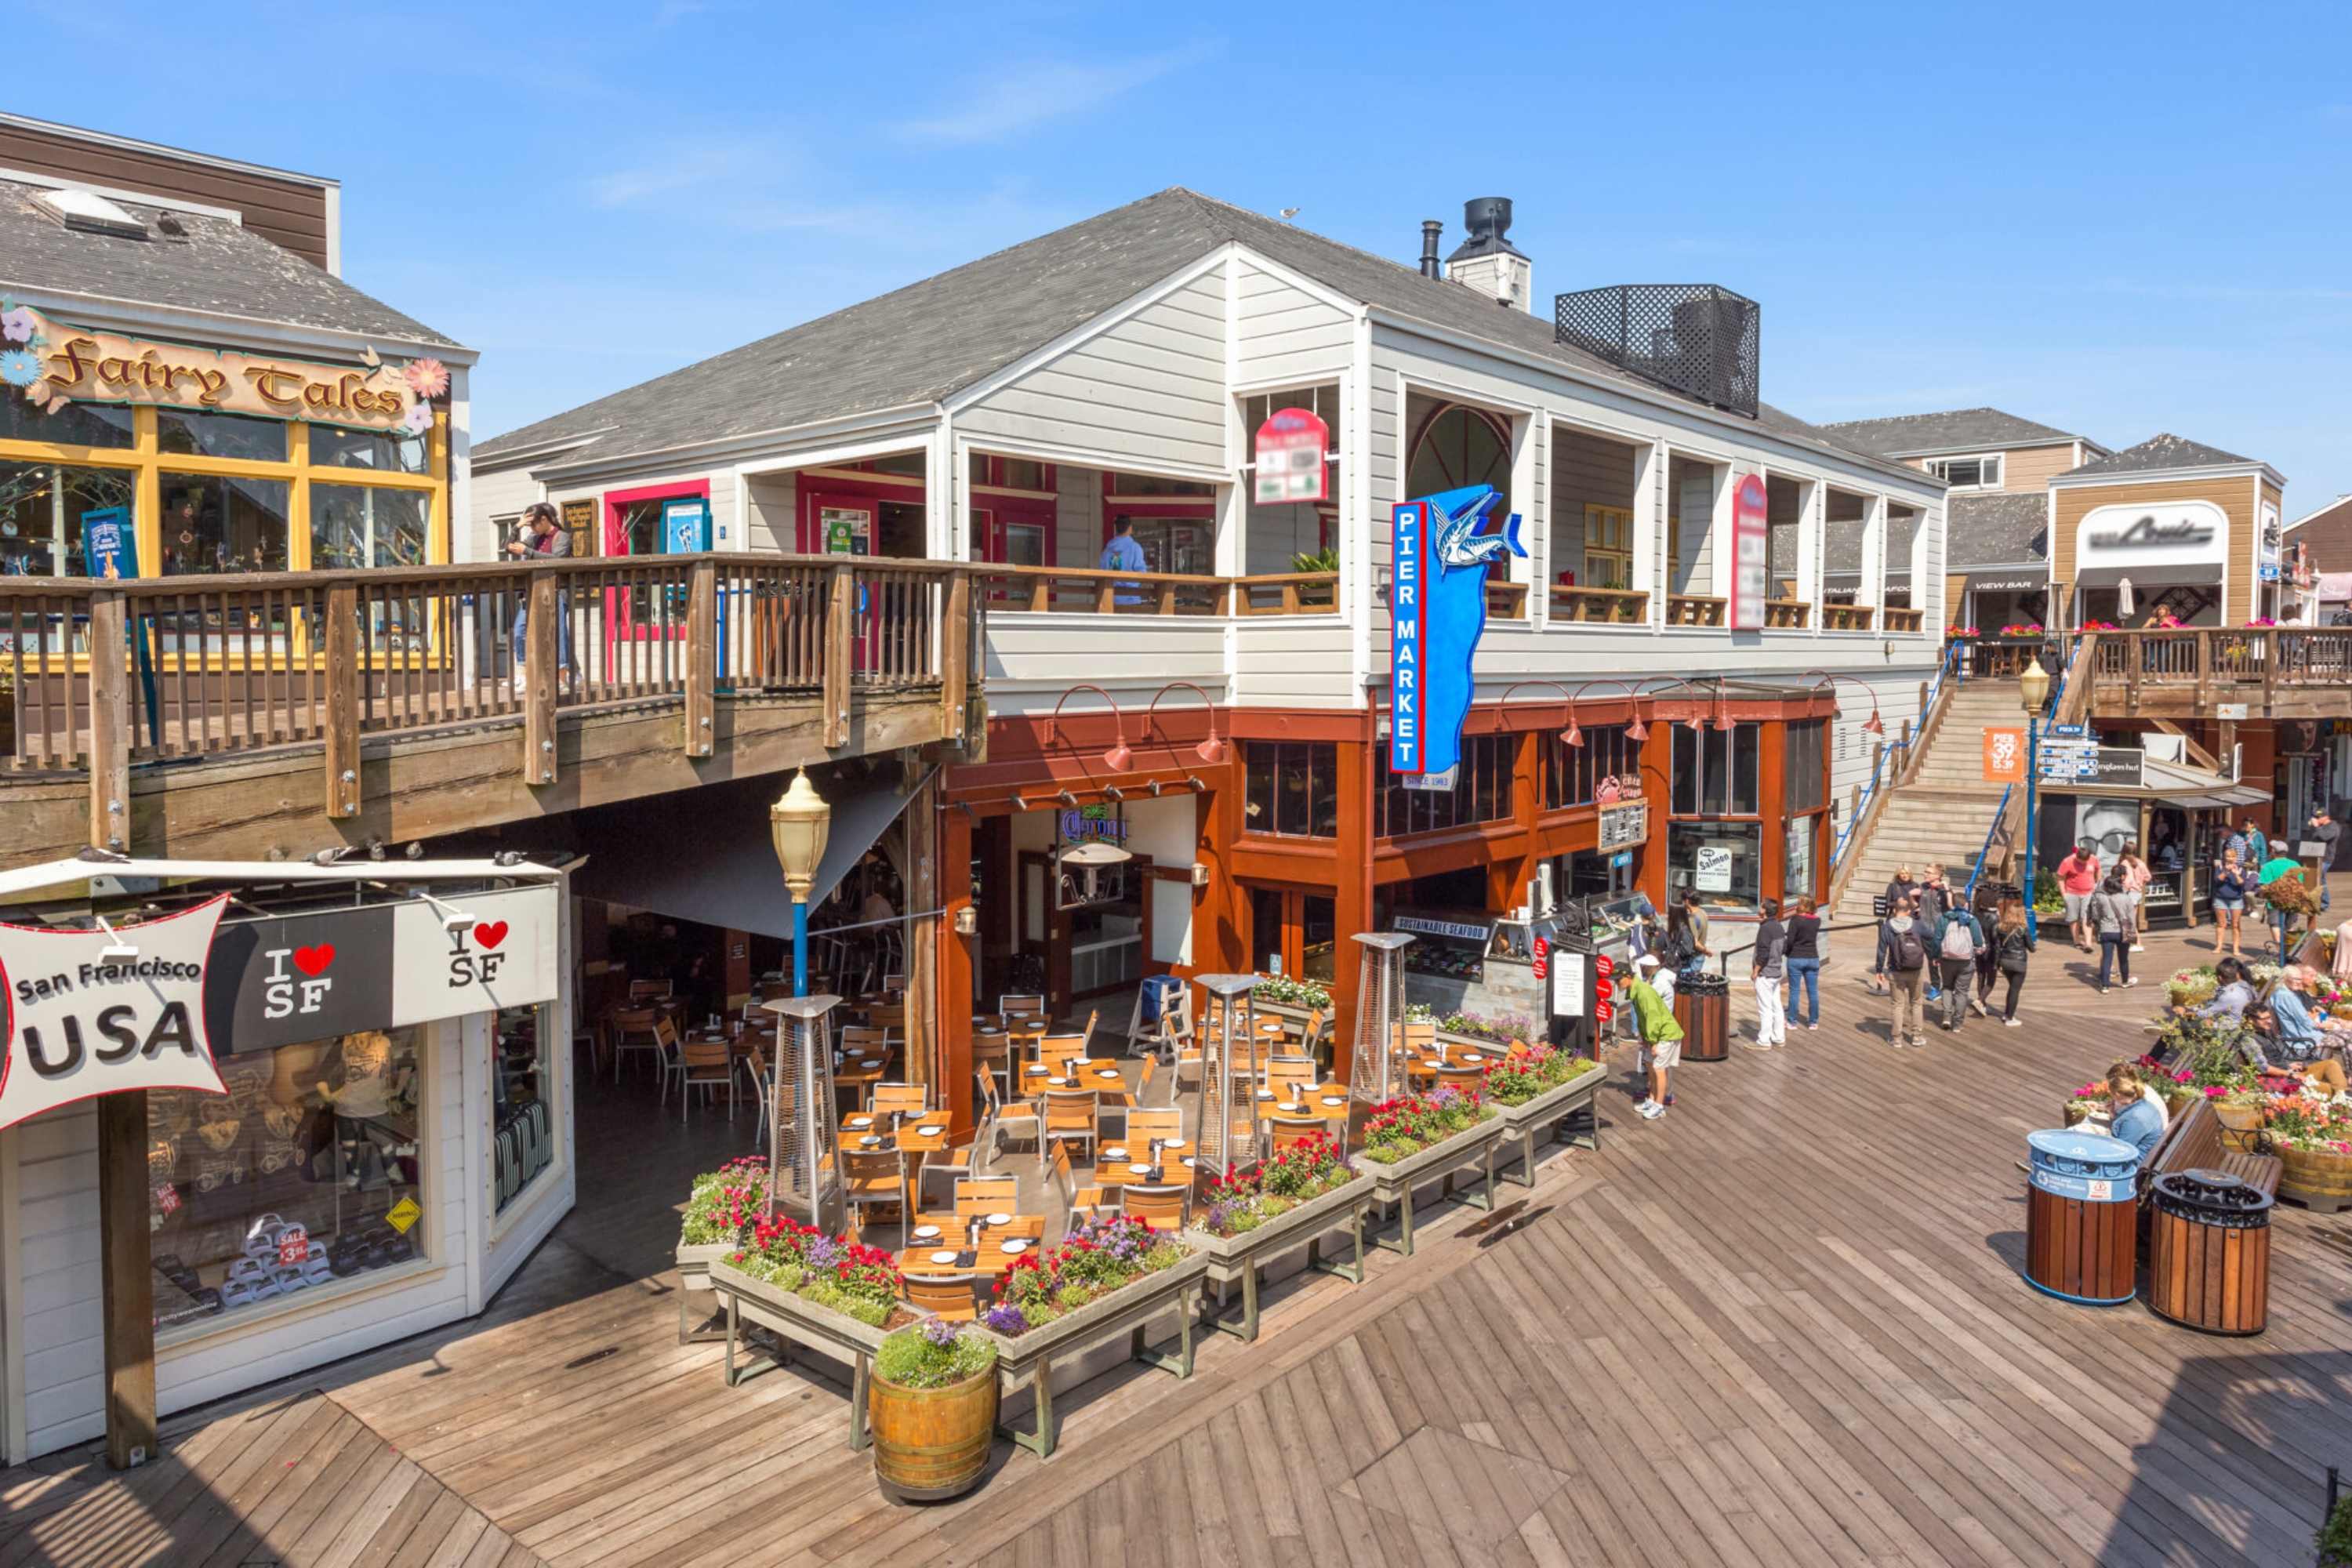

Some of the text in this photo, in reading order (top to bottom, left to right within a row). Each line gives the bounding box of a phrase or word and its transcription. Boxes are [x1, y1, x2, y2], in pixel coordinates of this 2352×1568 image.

[47, 337, 403, 416] Fairy Tales
[1399, 513, 1416, 605] PIER
[1396, 620, 1416, 762] MARKET
[1992, 742, 2015, 760] 39
[1993, 733, 2015, 743] PIER
[1432, 777, 1449, 786] 1983
[2097, 763, 2140, 771] unglass hut
[1699, 854, 1730, 870] Salmon
[1399, 918, 1484, 938] SUSTAINABLE SEAFOOD
[16, 956, 201, 1001] San Francisco
[264, 949, 292, 983] I
[449, 952, 505, 988] SF
[264, 978, 332, 1018] SF
[23, 1000, 195, 1077] USA
[281, 1231, 307, 1245] SALE
